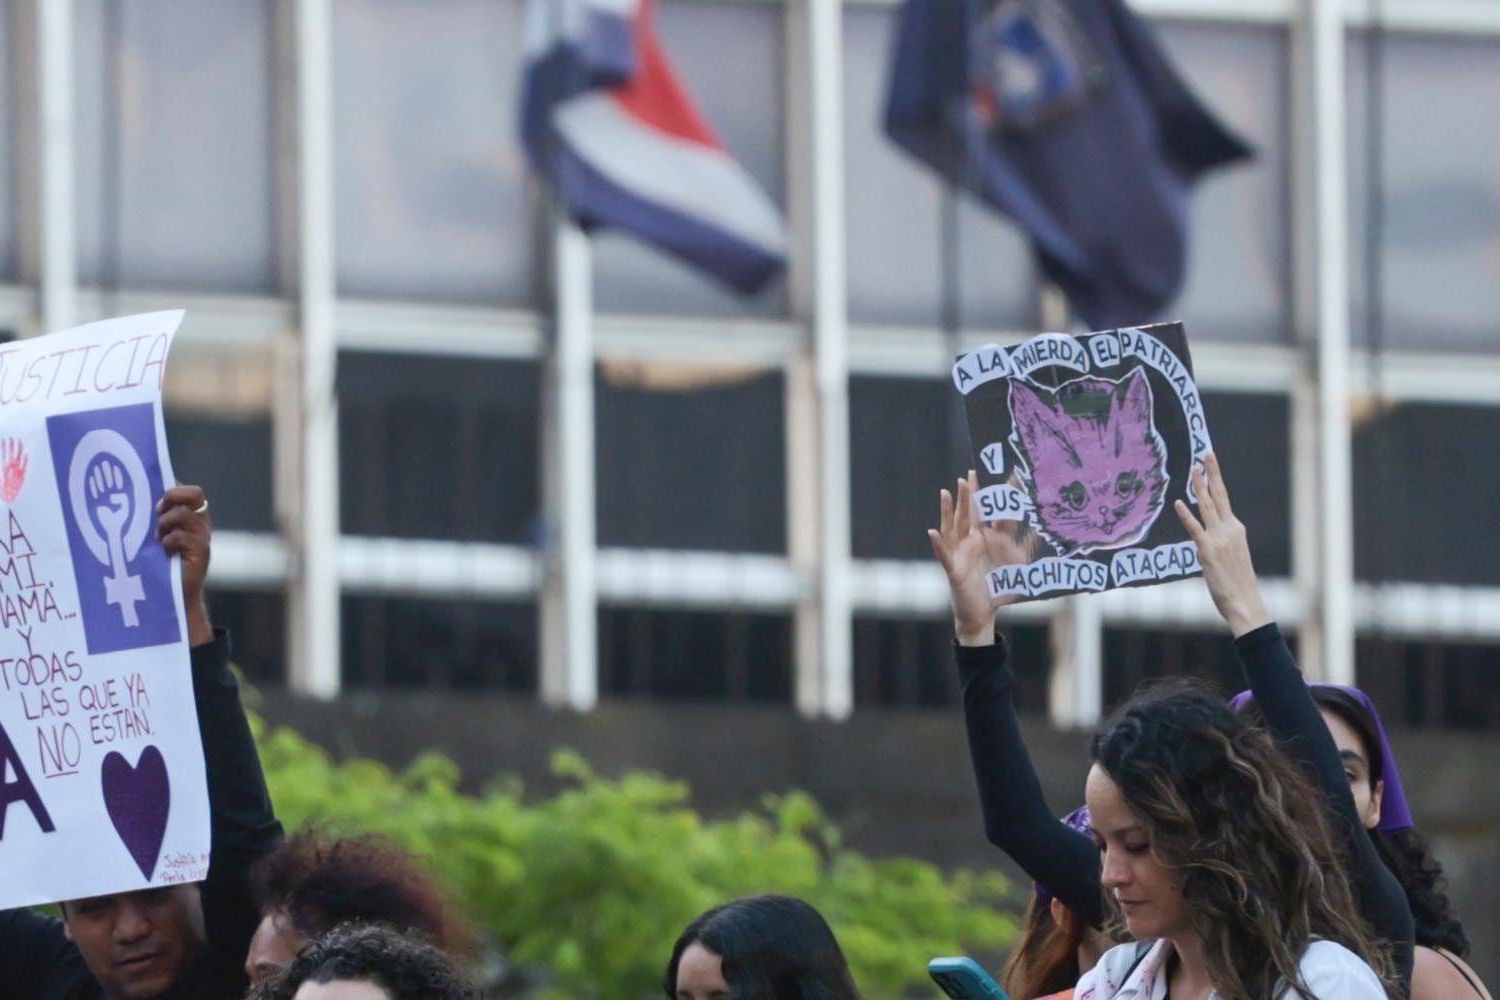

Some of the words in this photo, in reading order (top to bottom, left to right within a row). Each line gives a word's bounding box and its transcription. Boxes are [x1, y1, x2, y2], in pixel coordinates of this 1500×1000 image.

[957, 366, 972, 388] A
[977, 353, 1005, 373] LA
[1014, 338, 1086, 375] MIERDA
[1098, 337, 1118, 362] EL
[984, 448, 997, 470] Y
[980, 489, 1020, 516] SUS
[991, 562, 1105, 594] MACHITOS
[1115, 546, 1197, 586] ATACAD
[16, 626, 33, 657] Y
[20, 687, 69, 720] LAS
[79, 679, 119, 711] QUE
[123, 672, 150, 708] YA
[37, 721, 81, 774] NO
